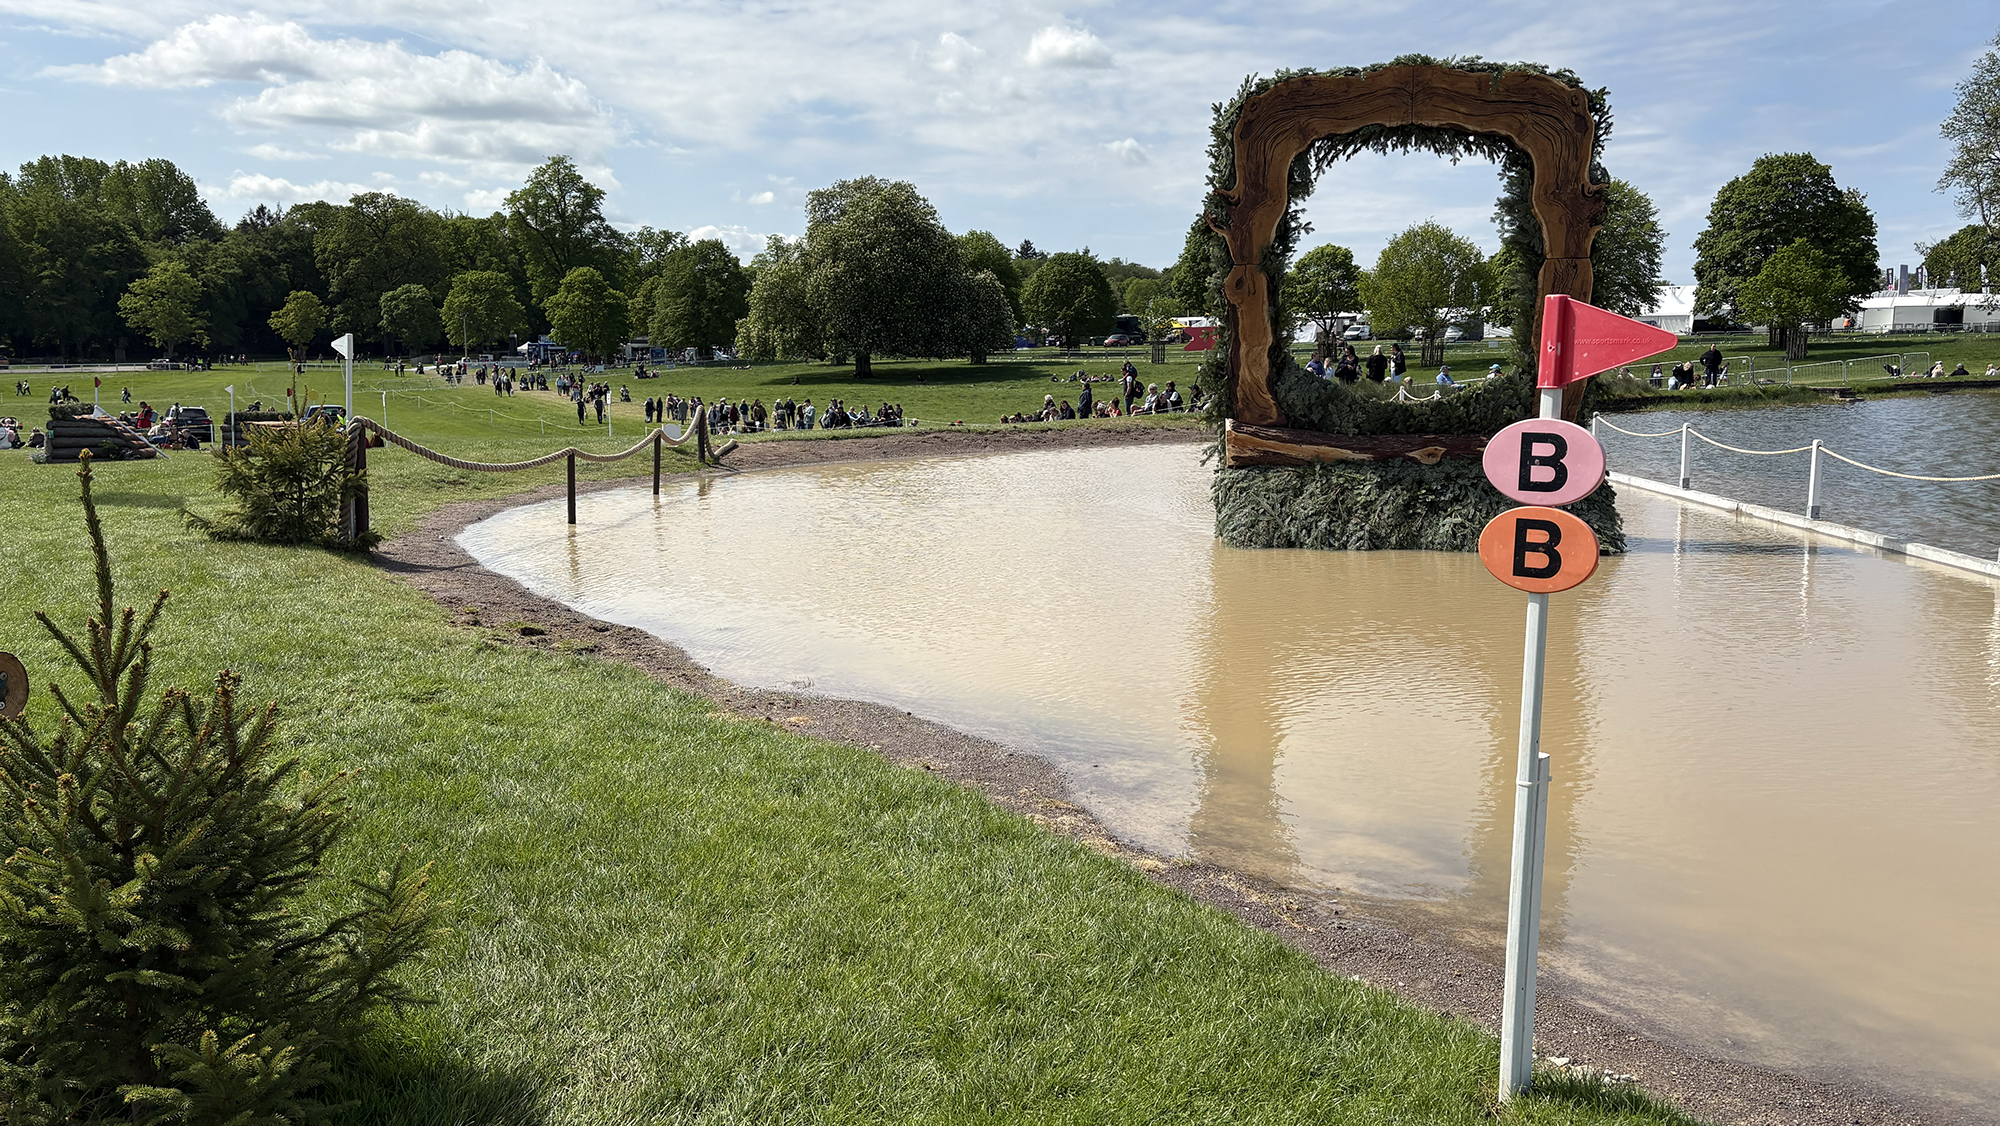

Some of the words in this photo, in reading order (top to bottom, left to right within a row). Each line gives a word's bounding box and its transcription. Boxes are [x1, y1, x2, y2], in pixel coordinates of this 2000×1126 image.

[1573, 336, 1652, 346] www.sportsmark.co.uk
[1518, 432, 1568, 493] B
[1512, 518, 1562, 579] B
